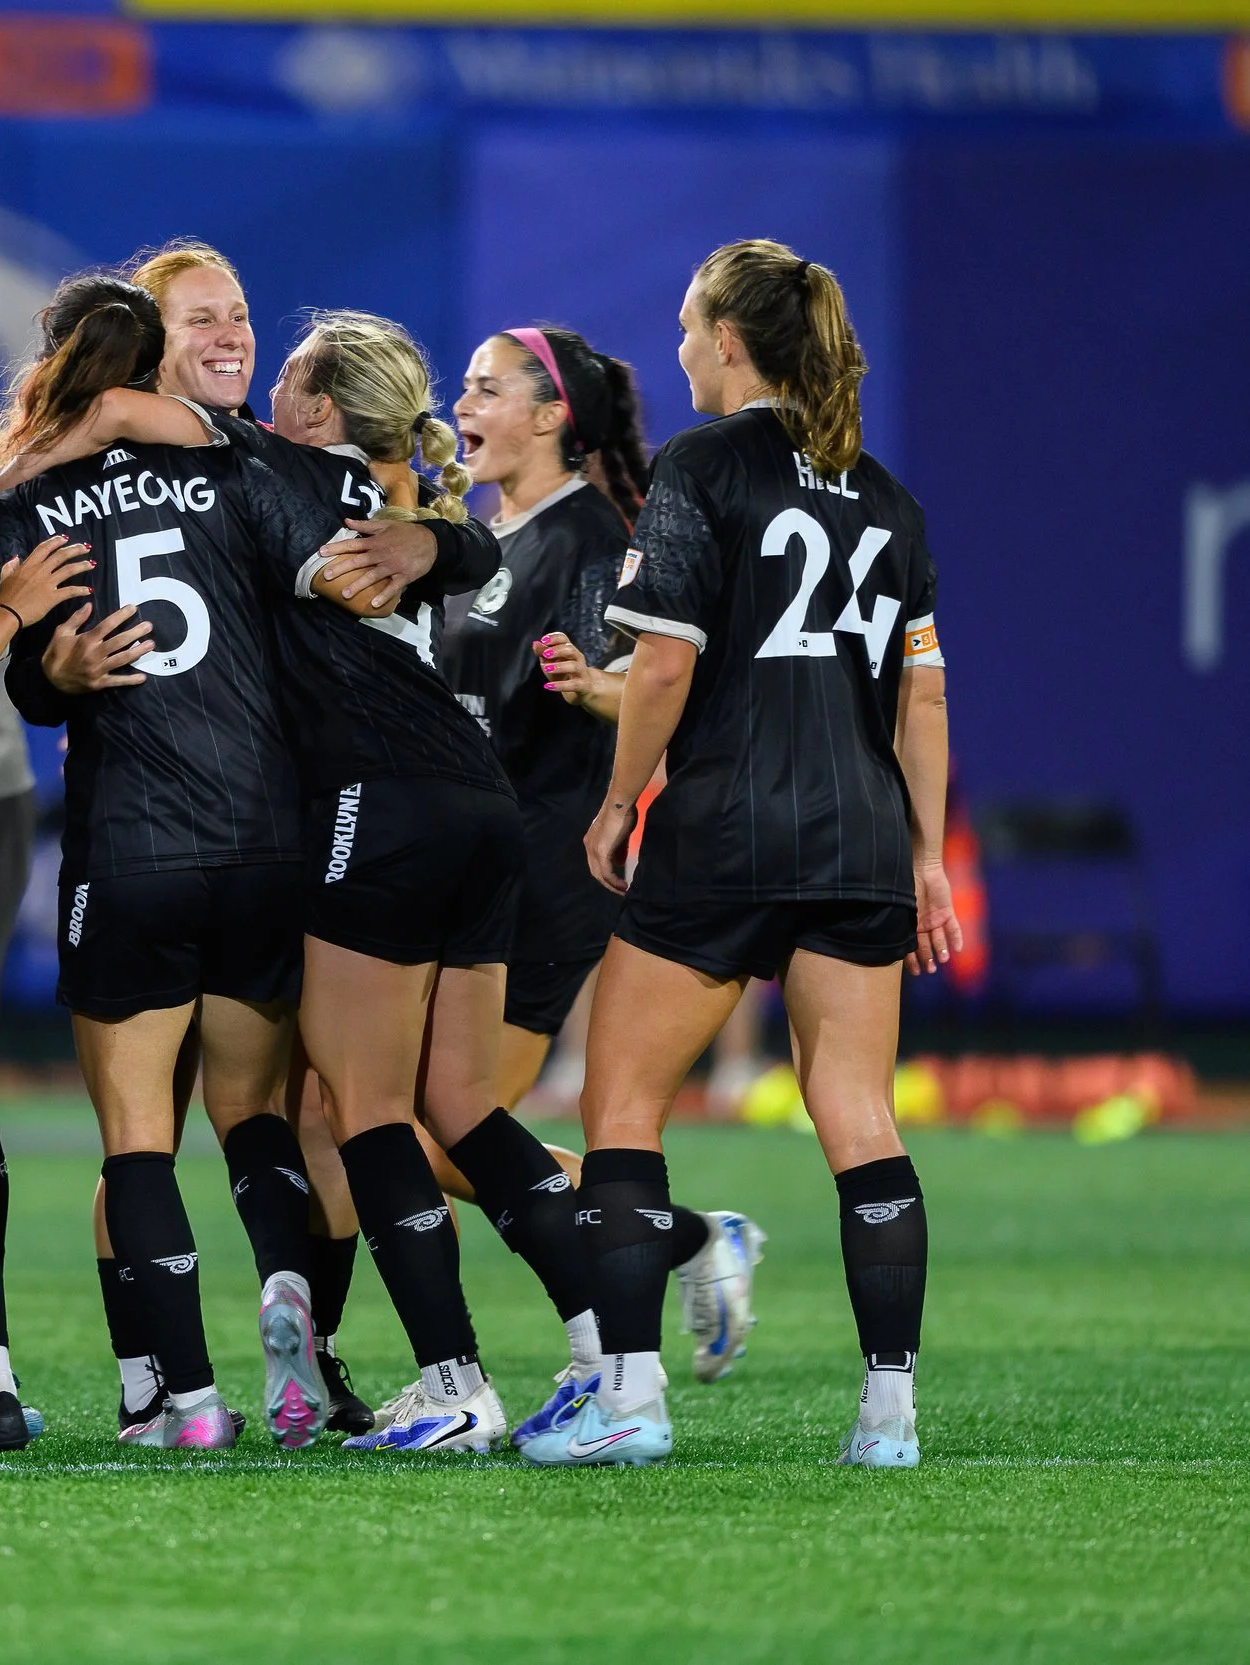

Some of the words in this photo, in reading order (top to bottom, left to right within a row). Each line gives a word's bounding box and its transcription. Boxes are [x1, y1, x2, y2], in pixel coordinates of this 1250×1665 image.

[35, 470, 216, 536] NAYEONG
[114, 527, 211, 677] 5
[753, 507, 902, 680] 24
